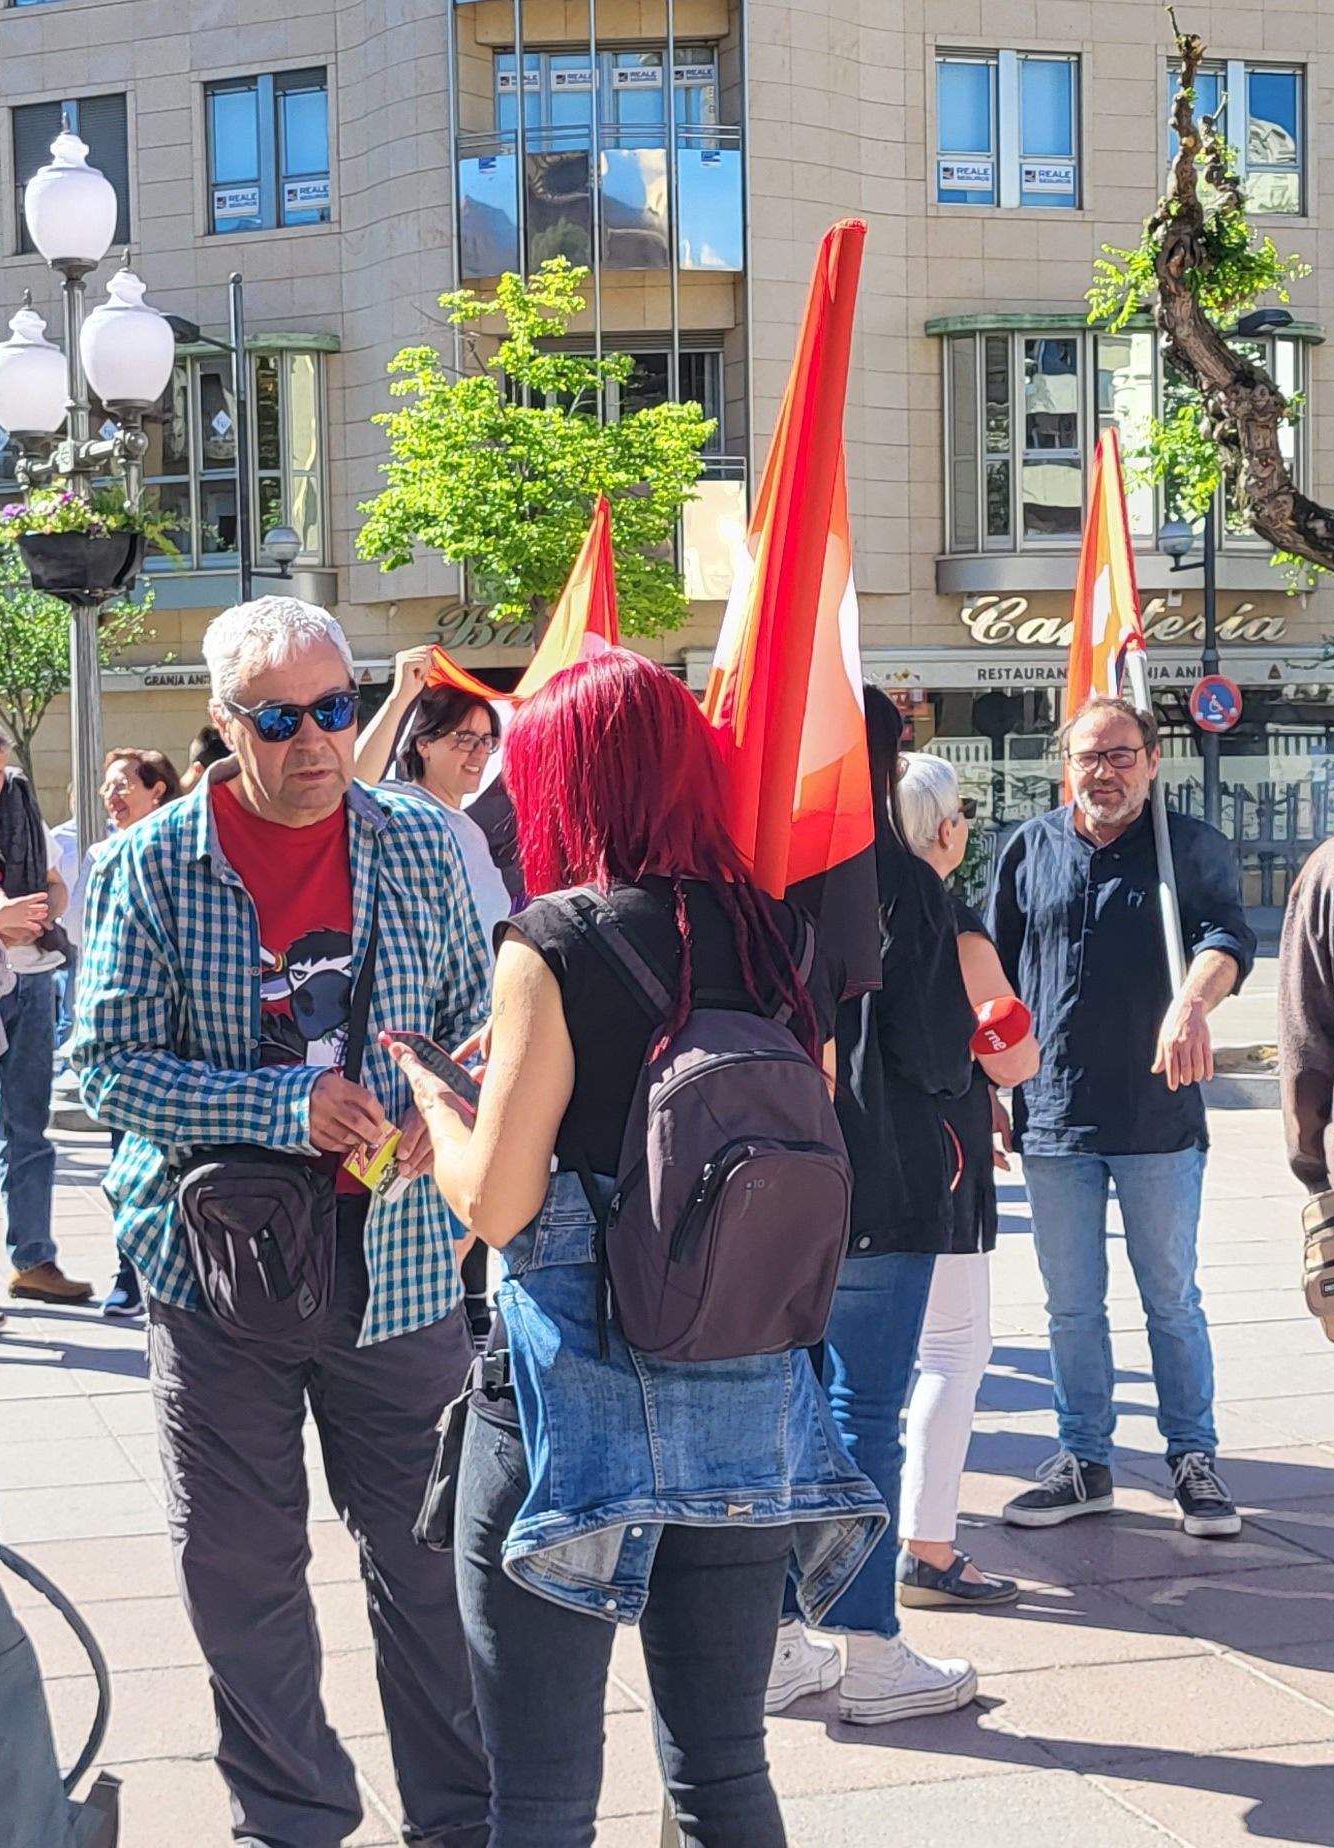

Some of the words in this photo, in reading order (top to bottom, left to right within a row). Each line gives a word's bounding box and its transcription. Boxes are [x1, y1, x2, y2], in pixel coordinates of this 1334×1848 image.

[956, 167, 990, 176] REALE
[1038, 170, 1071, 178] REALE
[228, 193, 257, 201] REALE
[424, 601, 534, 649] Ba
[977, 667, 1068, 681] RESTAURAN
[145, 675, 186, 686] GRANJA
[984, 1029, 1007, 1051] rne
